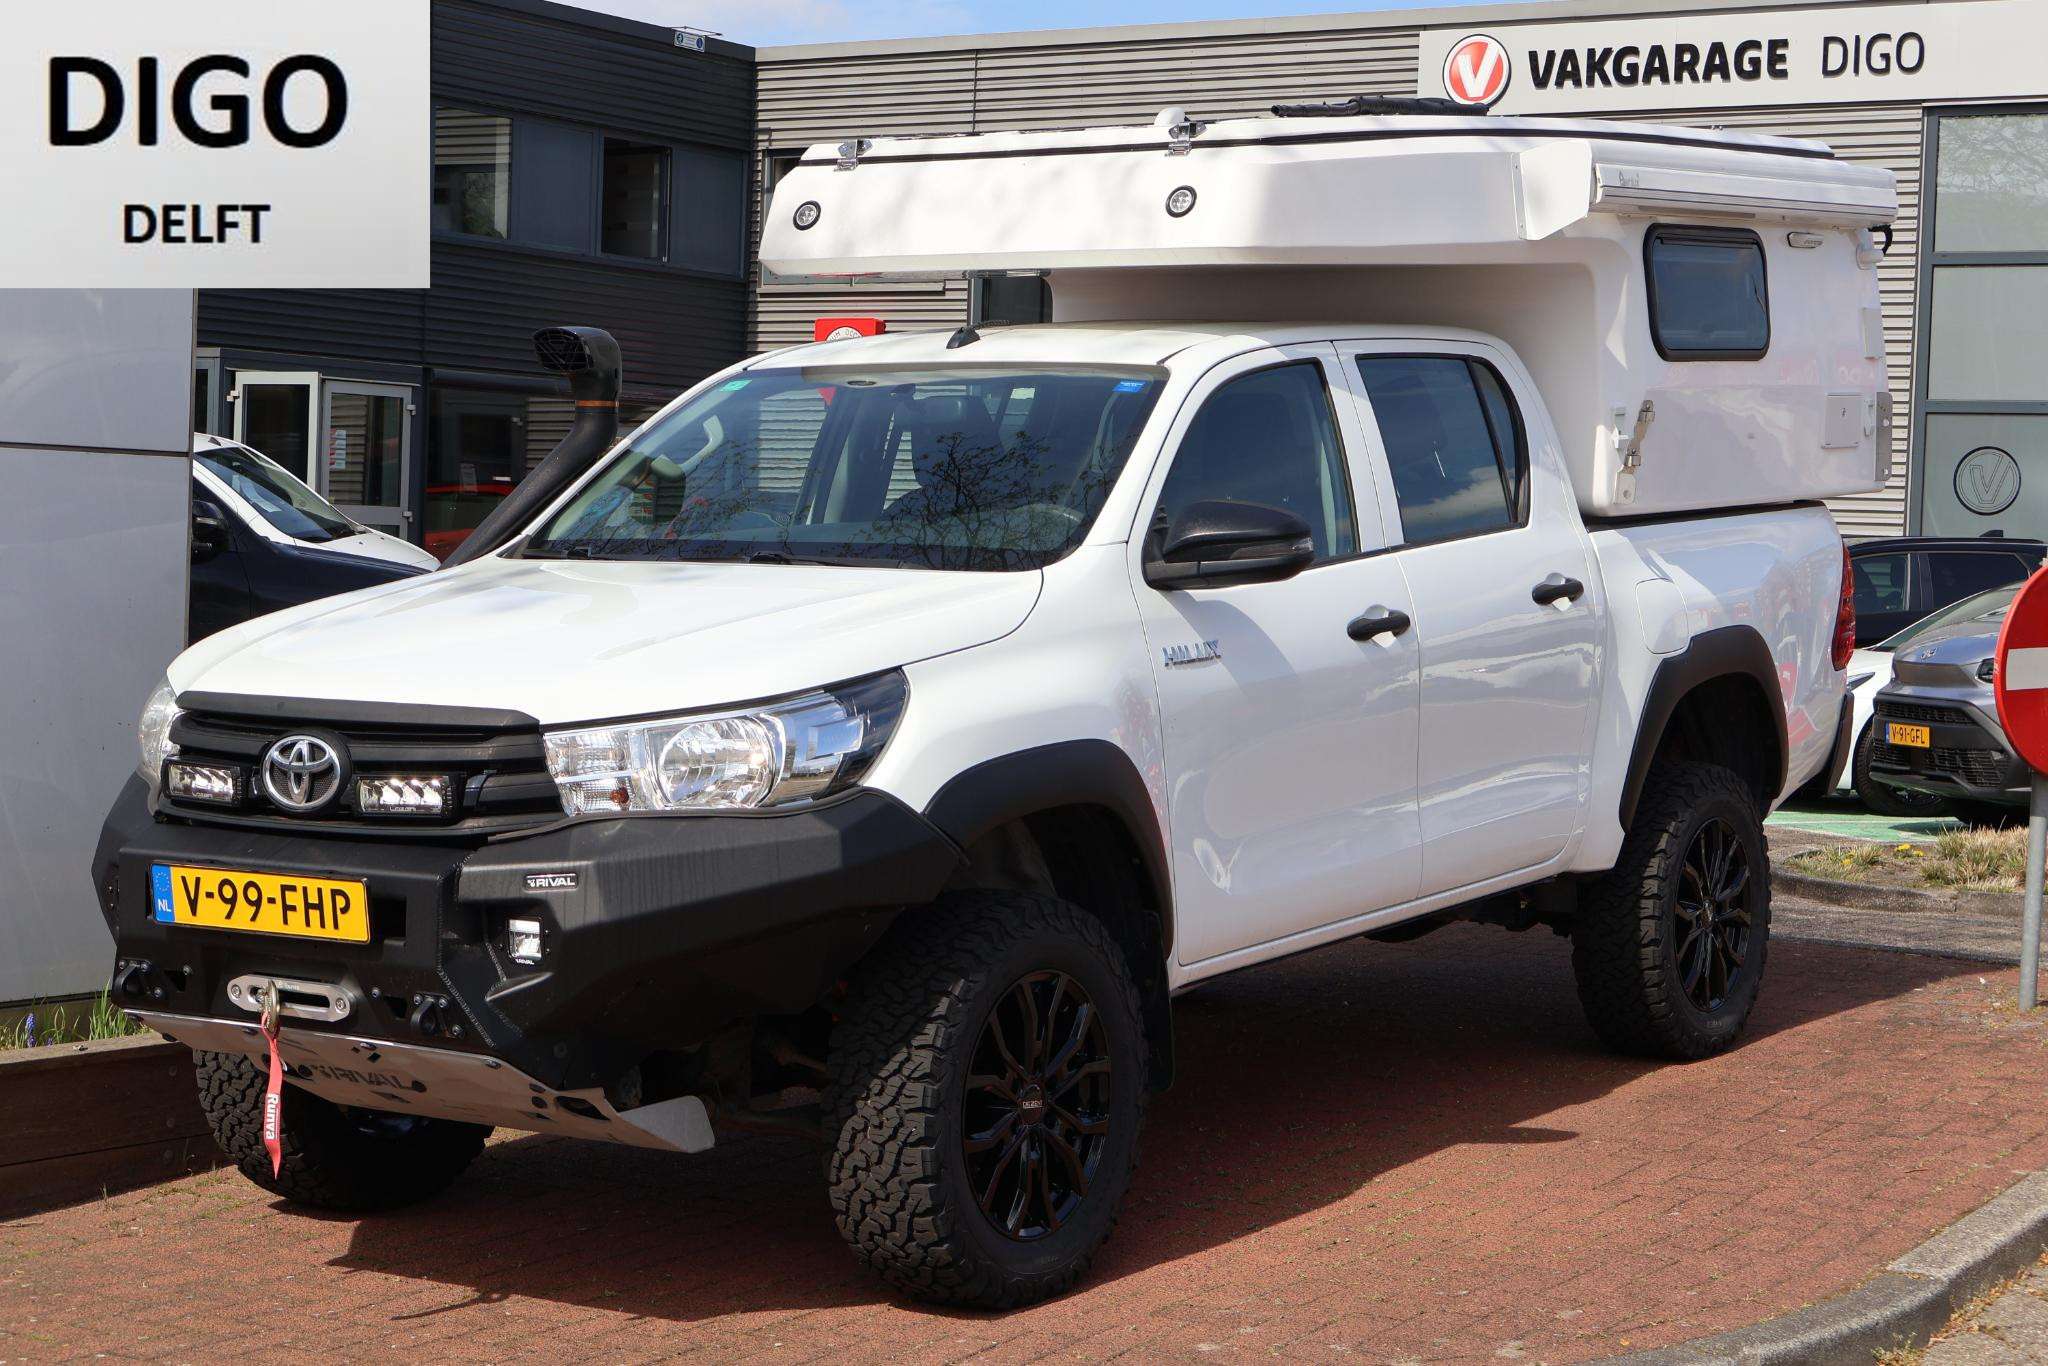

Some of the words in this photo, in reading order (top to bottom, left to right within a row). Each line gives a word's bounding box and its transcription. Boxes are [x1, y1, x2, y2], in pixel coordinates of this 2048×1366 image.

[1528, 39, 1790, 90] VAKGARAGE
[1821, 32, 1925, 79] DIGO
[158, 898, 172, 912] NL
[181, 876, 351, 930] V-99-FHP
[535, 877, 576, 888] RIVAL
[265, 1092, 280, 1140] Runva
